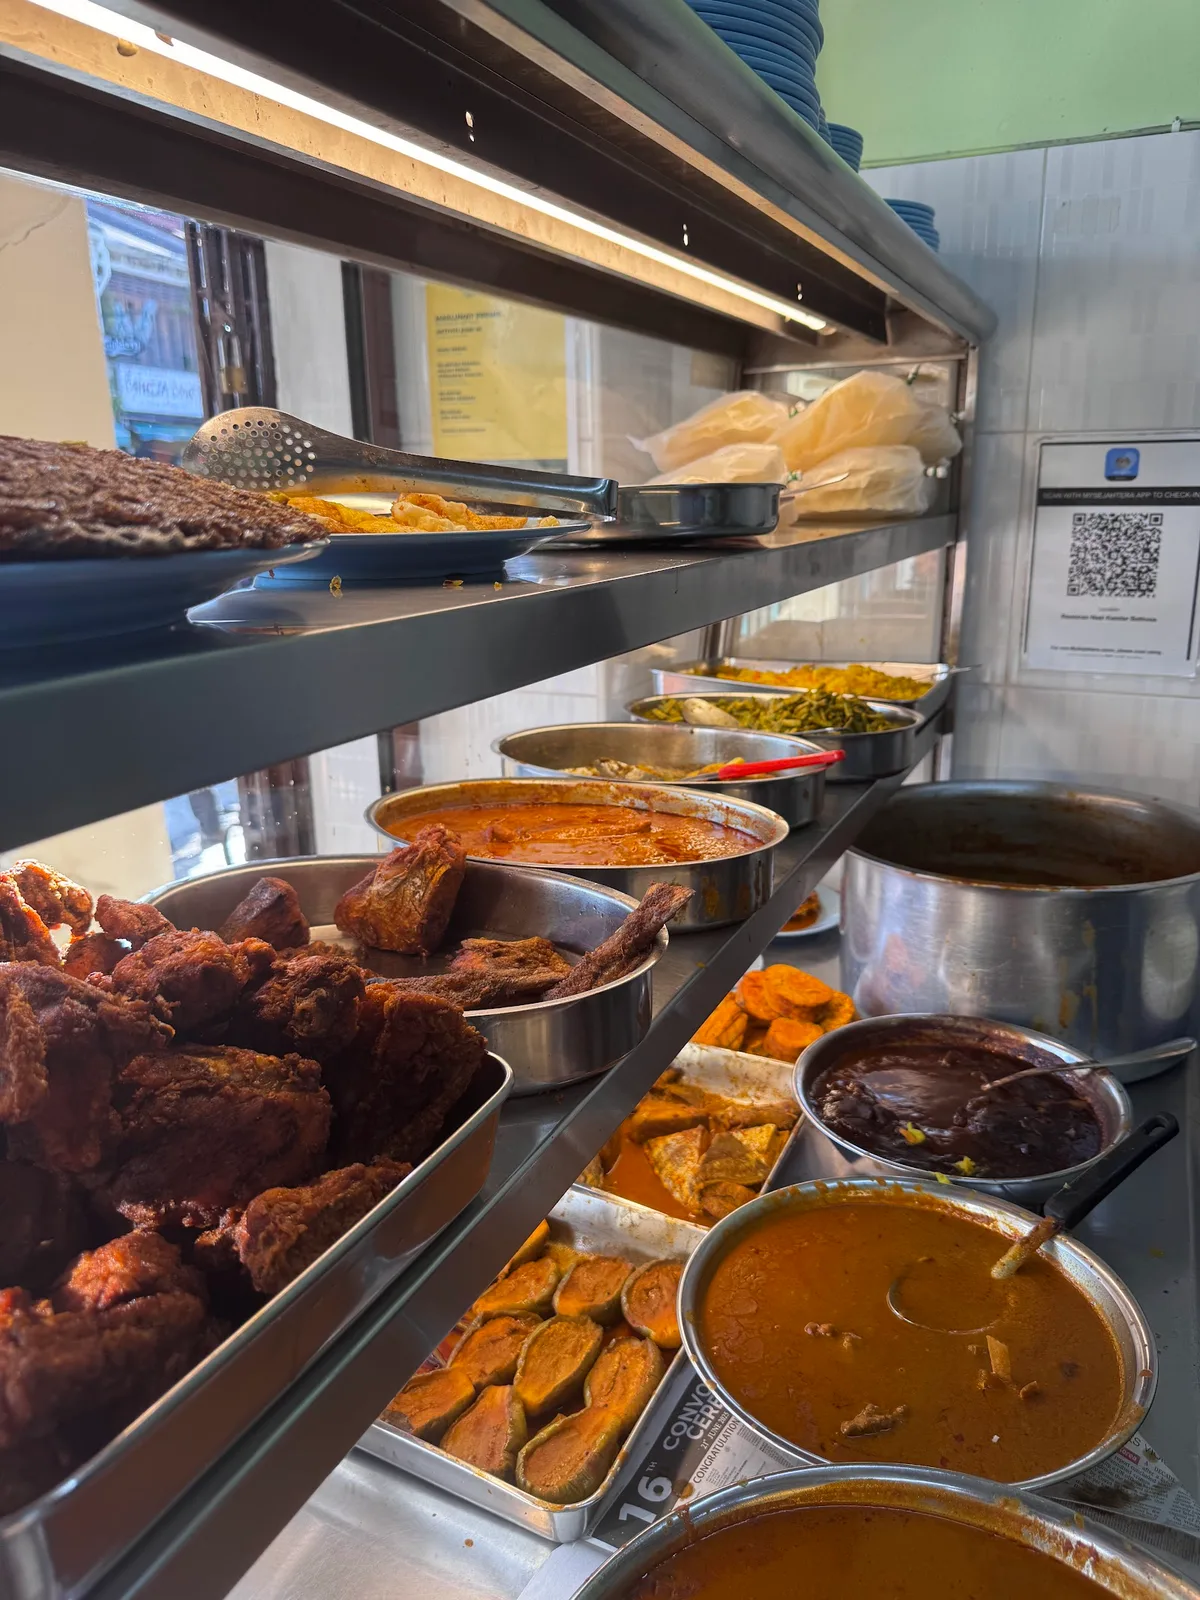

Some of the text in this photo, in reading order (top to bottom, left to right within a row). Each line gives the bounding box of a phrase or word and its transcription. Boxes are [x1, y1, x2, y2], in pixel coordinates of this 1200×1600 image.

[1136, 491, 1151, 499] APP
[1153, 491, 1163, 499] TO
[707, 1421, 721, 1440] JUNE
